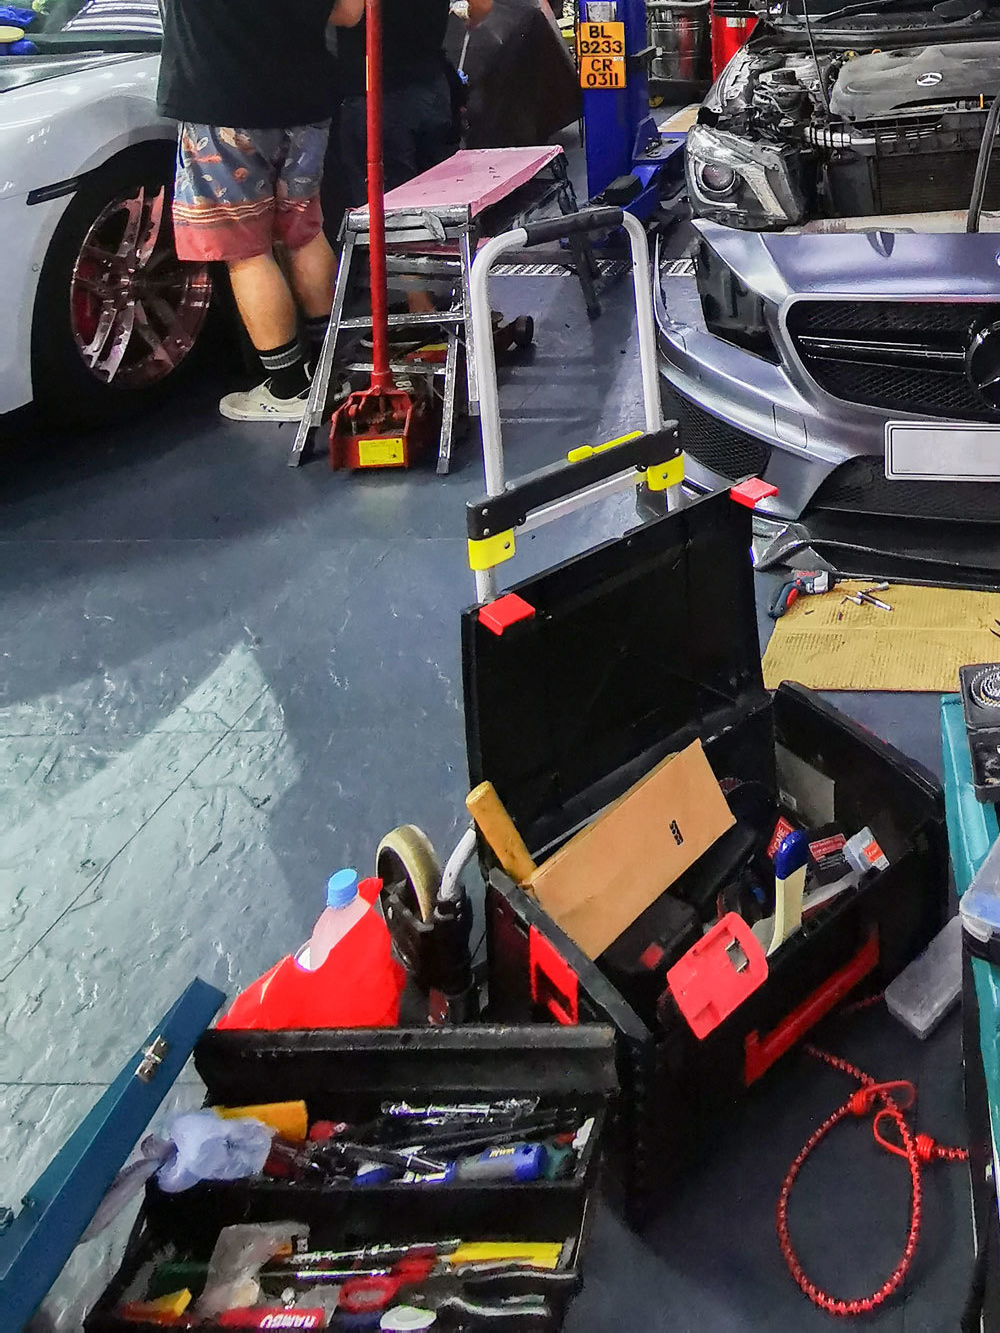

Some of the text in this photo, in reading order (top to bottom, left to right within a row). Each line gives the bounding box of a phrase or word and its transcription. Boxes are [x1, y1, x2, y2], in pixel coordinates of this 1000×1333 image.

[588, 25, 612, 40] BL
[580, 40, 623, 55] 3233
[590, 58, 613, 73] CR
[586, 71, 619, 87] 0311
